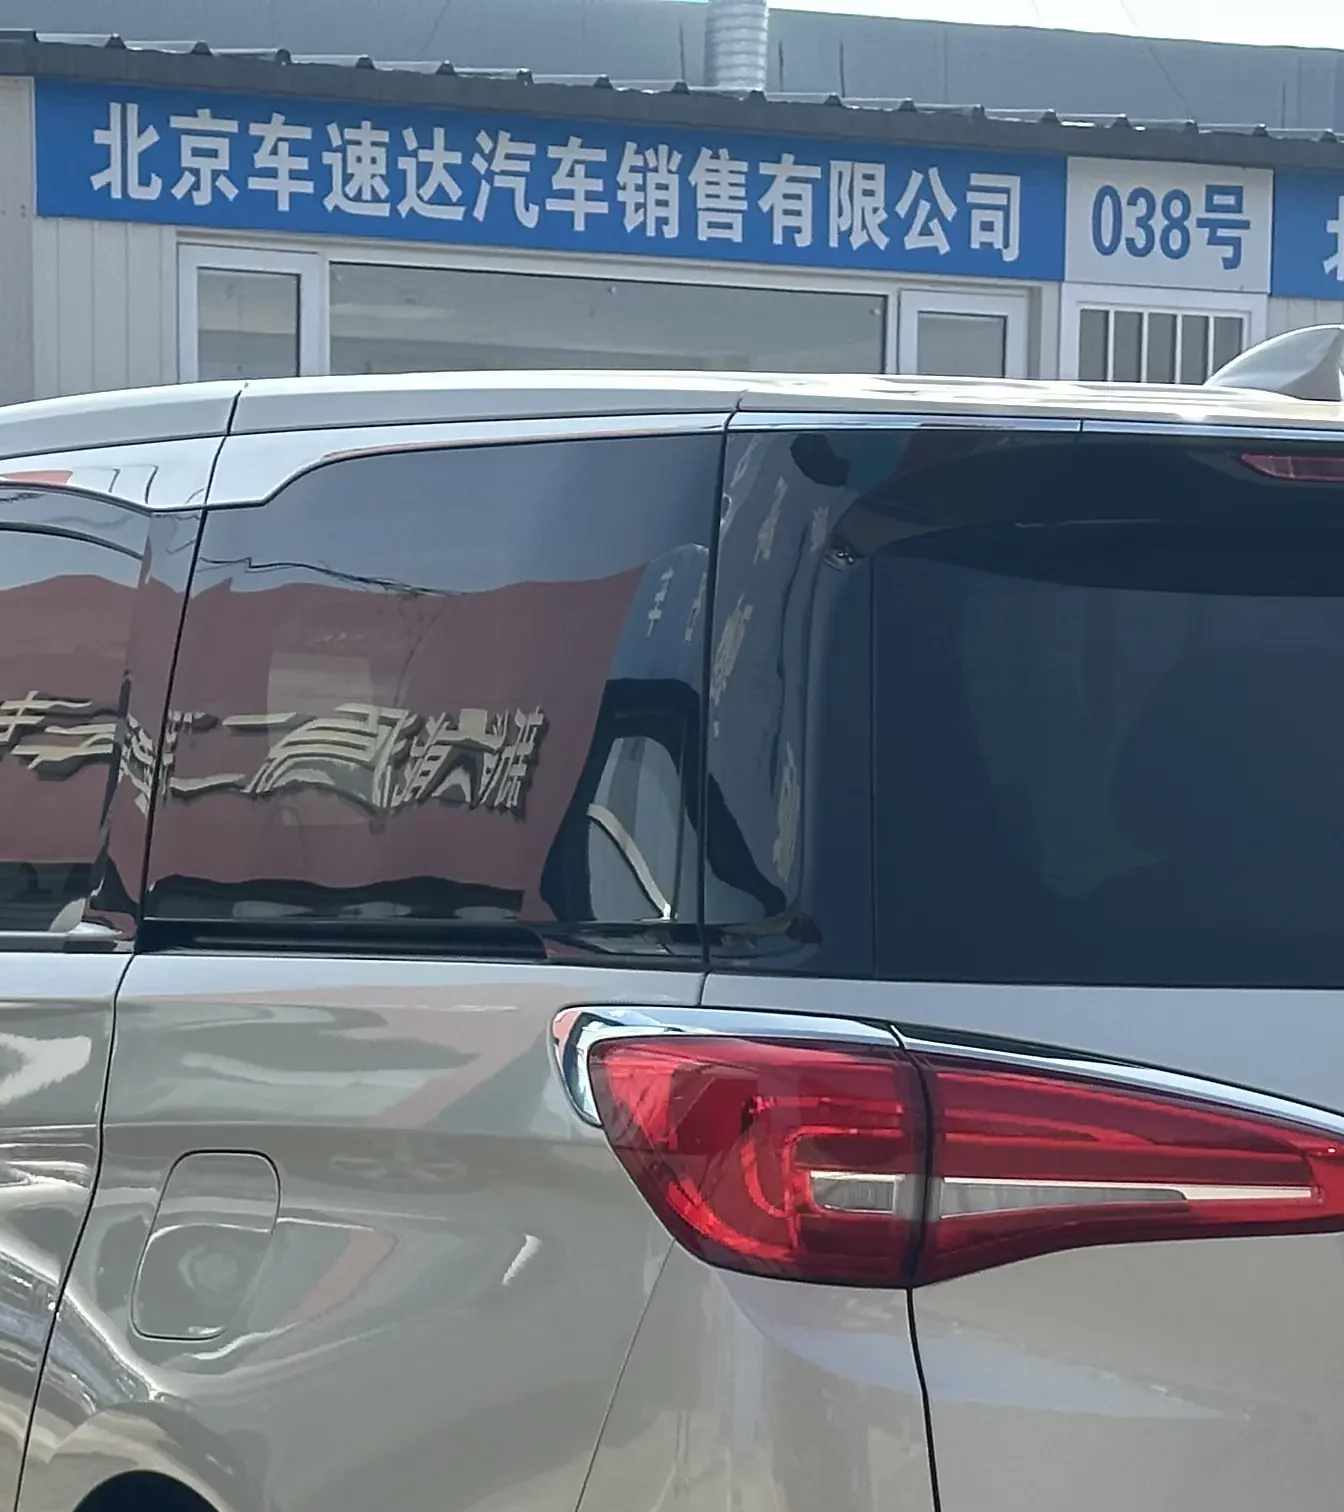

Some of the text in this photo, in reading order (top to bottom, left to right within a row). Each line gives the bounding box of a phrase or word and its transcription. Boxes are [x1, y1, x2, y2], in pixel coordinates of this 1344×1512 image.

[89, 101, 1021, 262] 北京车速达汽车销售有限公司
[1091, 184, 1251, 270] 038号
